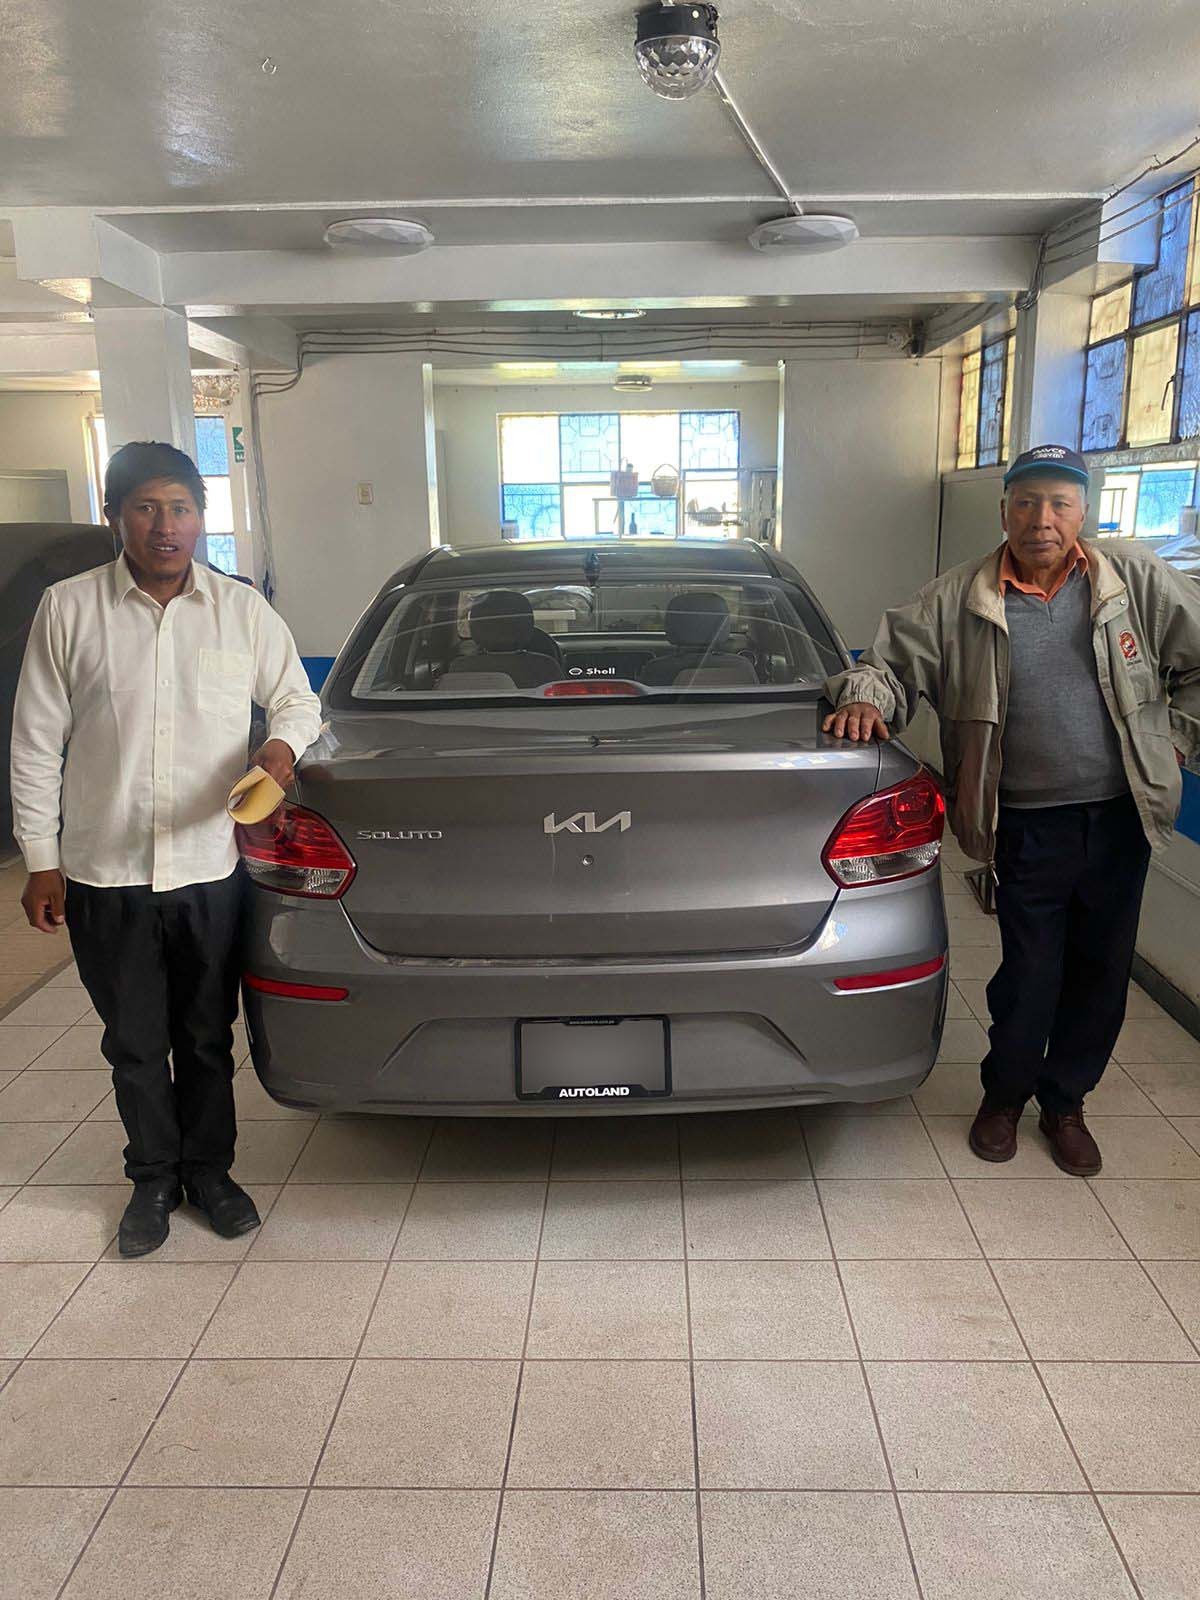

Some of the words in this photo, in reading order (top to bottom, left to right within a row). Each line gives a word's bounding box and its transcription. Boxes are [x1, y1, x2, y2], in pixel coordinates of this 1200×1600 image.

[585, 667, 616, 675] Shell
[543, 811, 632, 834] KIA
[356, 829, 443, 840] SOLUTO
[558, 1086, 630, 1098] AUTOLAND
